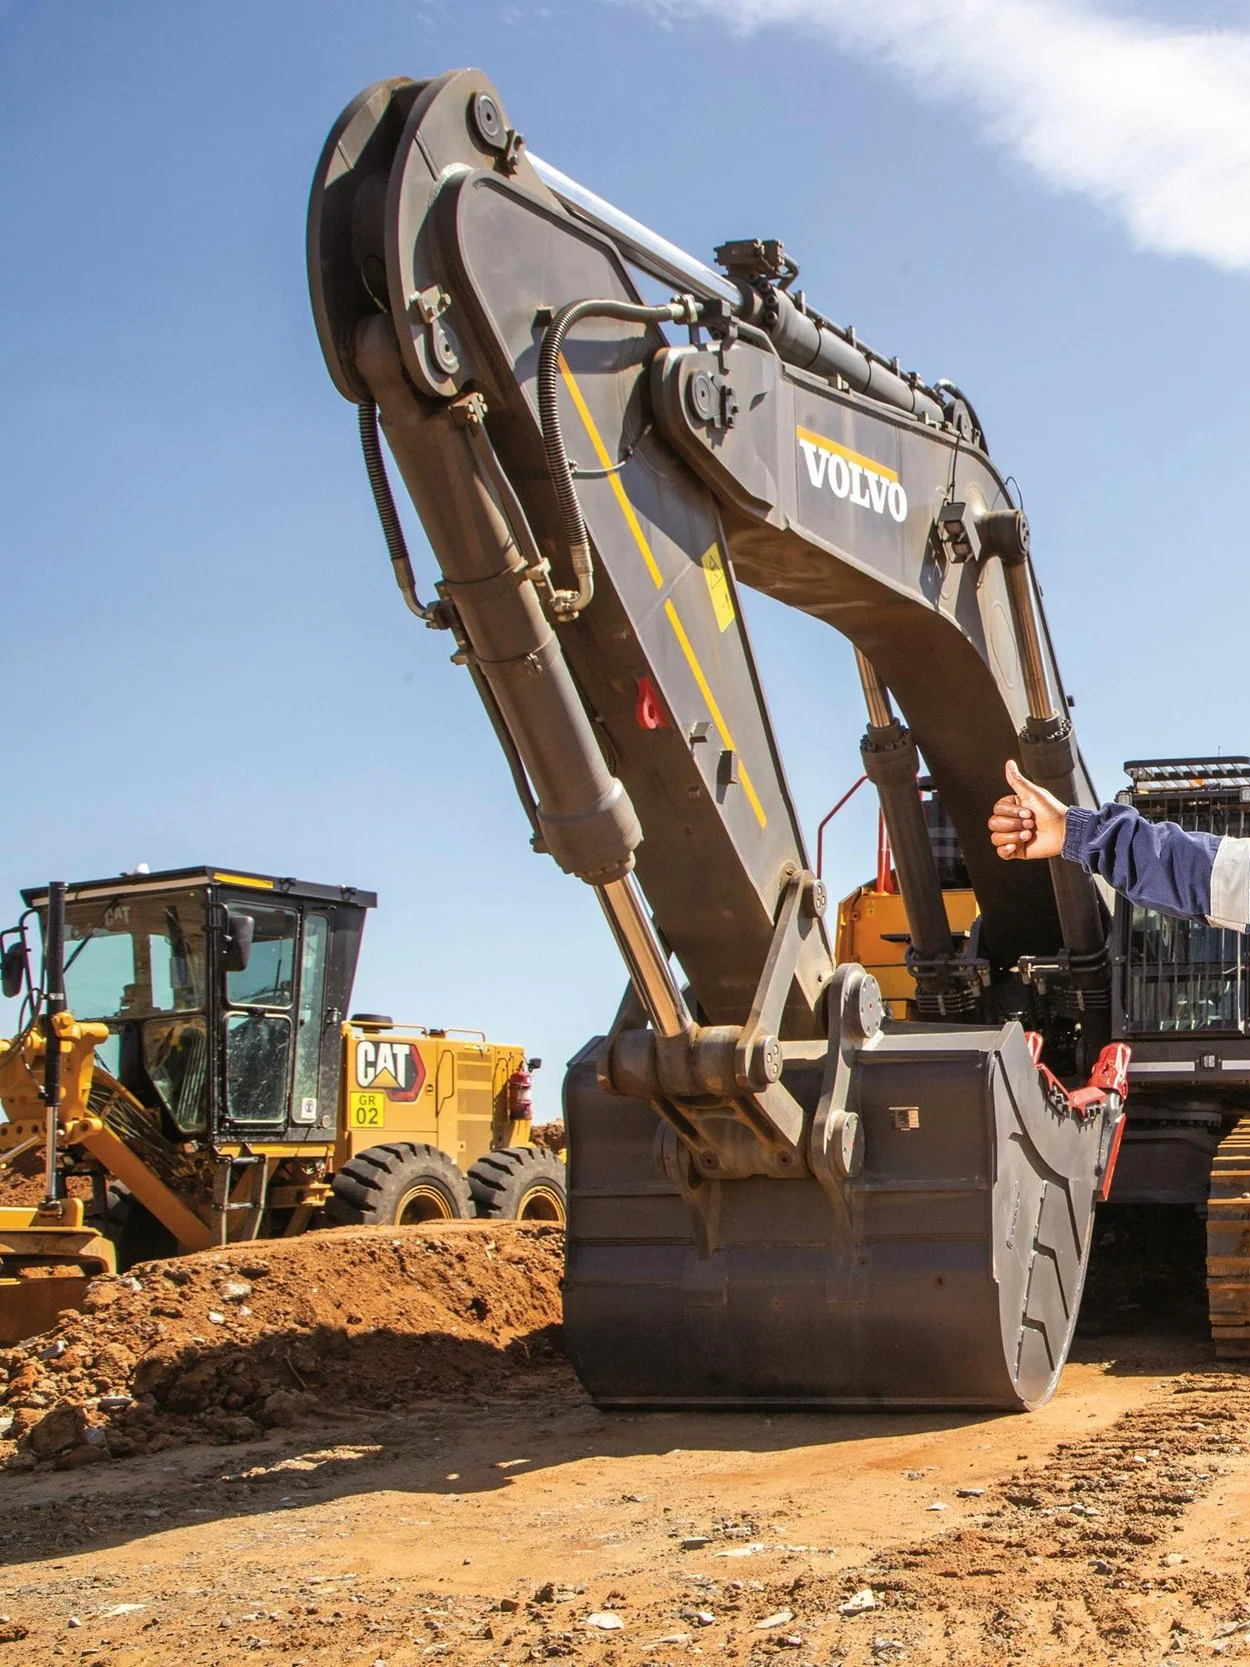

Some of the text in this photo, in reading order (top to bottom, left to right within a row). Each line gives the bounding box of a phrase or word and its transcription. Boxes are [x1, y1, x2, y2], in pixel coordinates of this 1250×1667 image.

[799, 438, 908, 523] VOLVO
[104, 906, 131, 927] CAT
[357, 1041, 410, 1088] CAT
[359, 1095, 376, 1106] GR
[356, 1107, 379, 1125] 02
